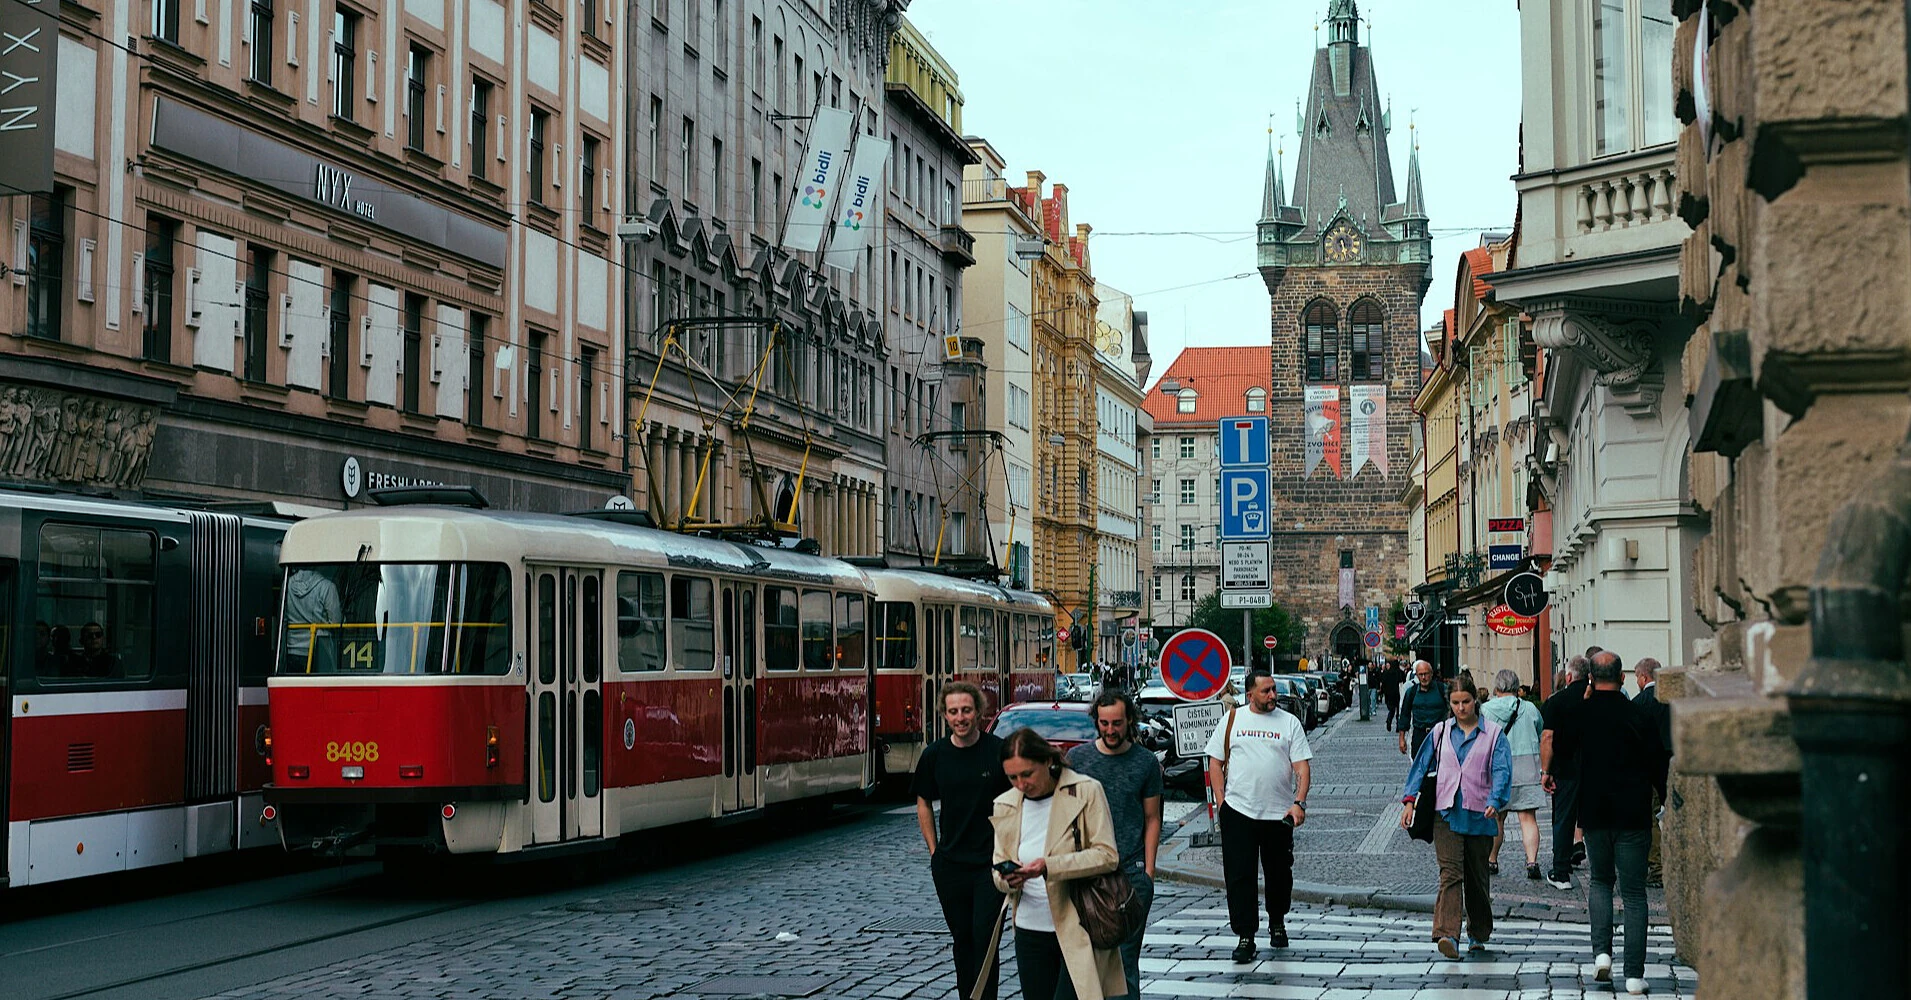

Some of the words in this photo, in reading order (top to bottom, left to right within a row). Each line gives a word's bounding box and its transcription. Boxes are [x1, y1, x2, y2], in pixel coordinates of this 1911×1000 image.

[1, 27, 41, 131] NYX
[812, 150, 832, 184] bidli
[317, 163, 352, 210] NYX
[356, 200, 375, 219] HOTEL
[853, 176, 870, 207] bidli
[949, 341, 958, 351] 10
[1305, 405, 1339, 414] RESTAURANT
[1231, 478, 1259, 516] P
[1489, 519, 1523, 531] PIZZA
[1492, 553, 1519, 561] CHANGE
[1239, 596, 1266, 604] P1-0488
[1489, 604, 1510, 618] RISTO
[1495, 625, 1529, 634] PIZZERIA
[343, 641, 373, 668] 14
[1187, 708, 1212, 719] ČIŠTĚNÍ
[1205, 729, 1215, 738] 20
[326, 741, 379, 762] 8498
